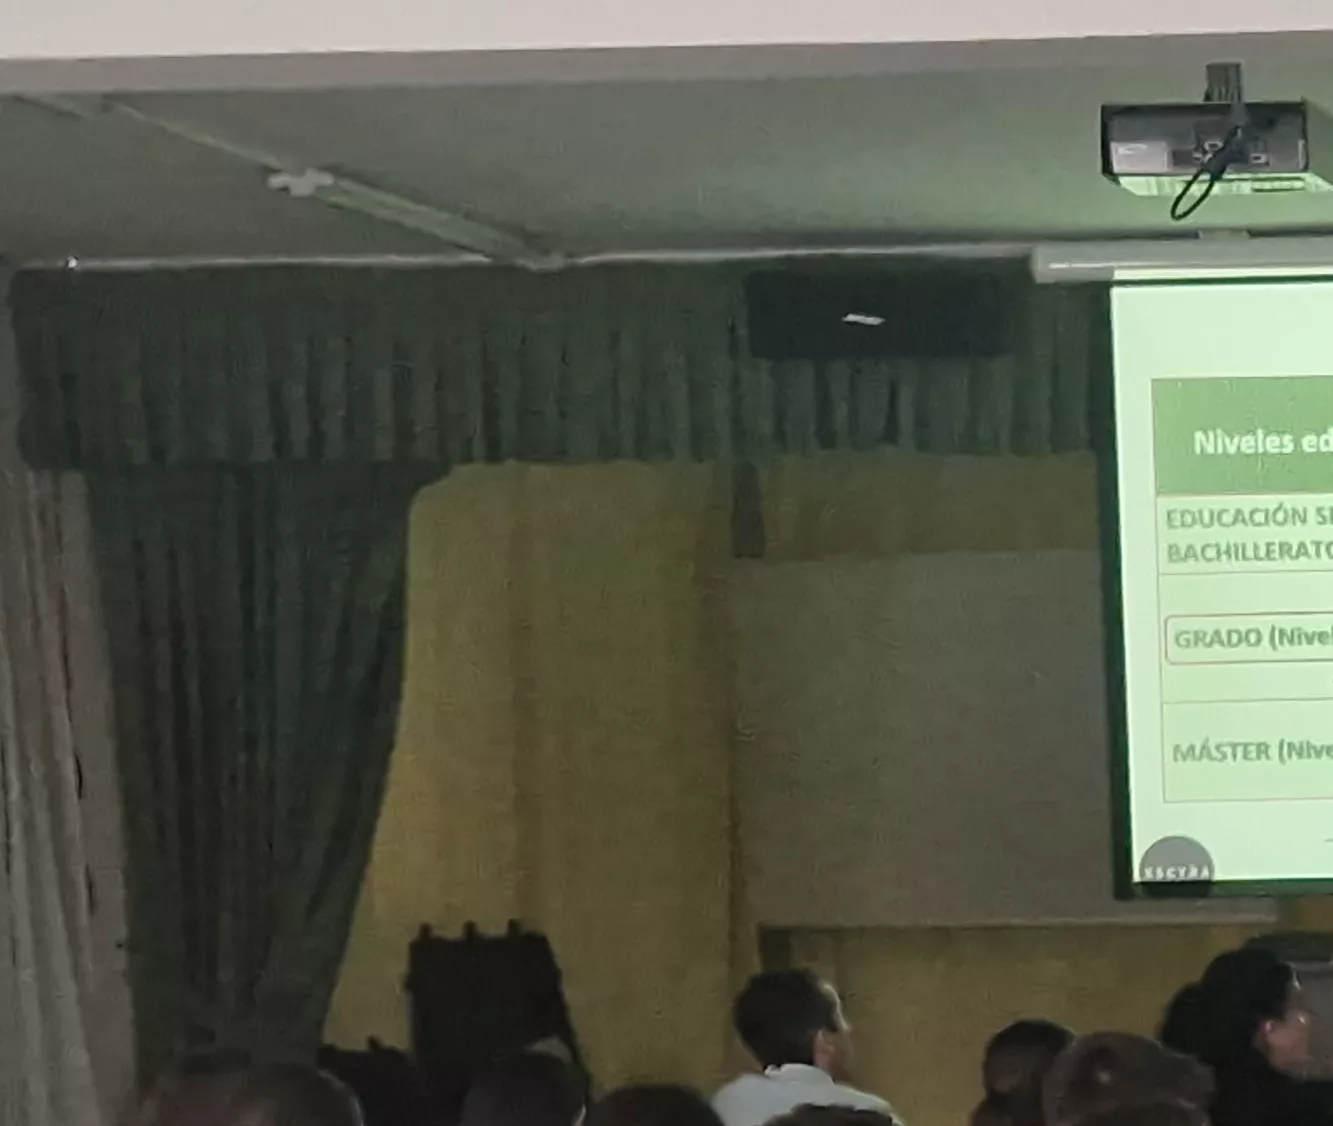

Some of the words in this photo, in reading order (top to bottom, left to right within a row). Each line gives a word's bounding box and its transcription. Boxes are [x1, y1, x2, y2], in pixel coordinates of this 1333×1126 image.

[1193, 428, 1294, 455] Niveles
[1166, 502, 1307, 530] EDUCACIÓN
[1174, 628, 1263, 649] GRADO
[1172, 736, 1271, 763] MÁSTER
